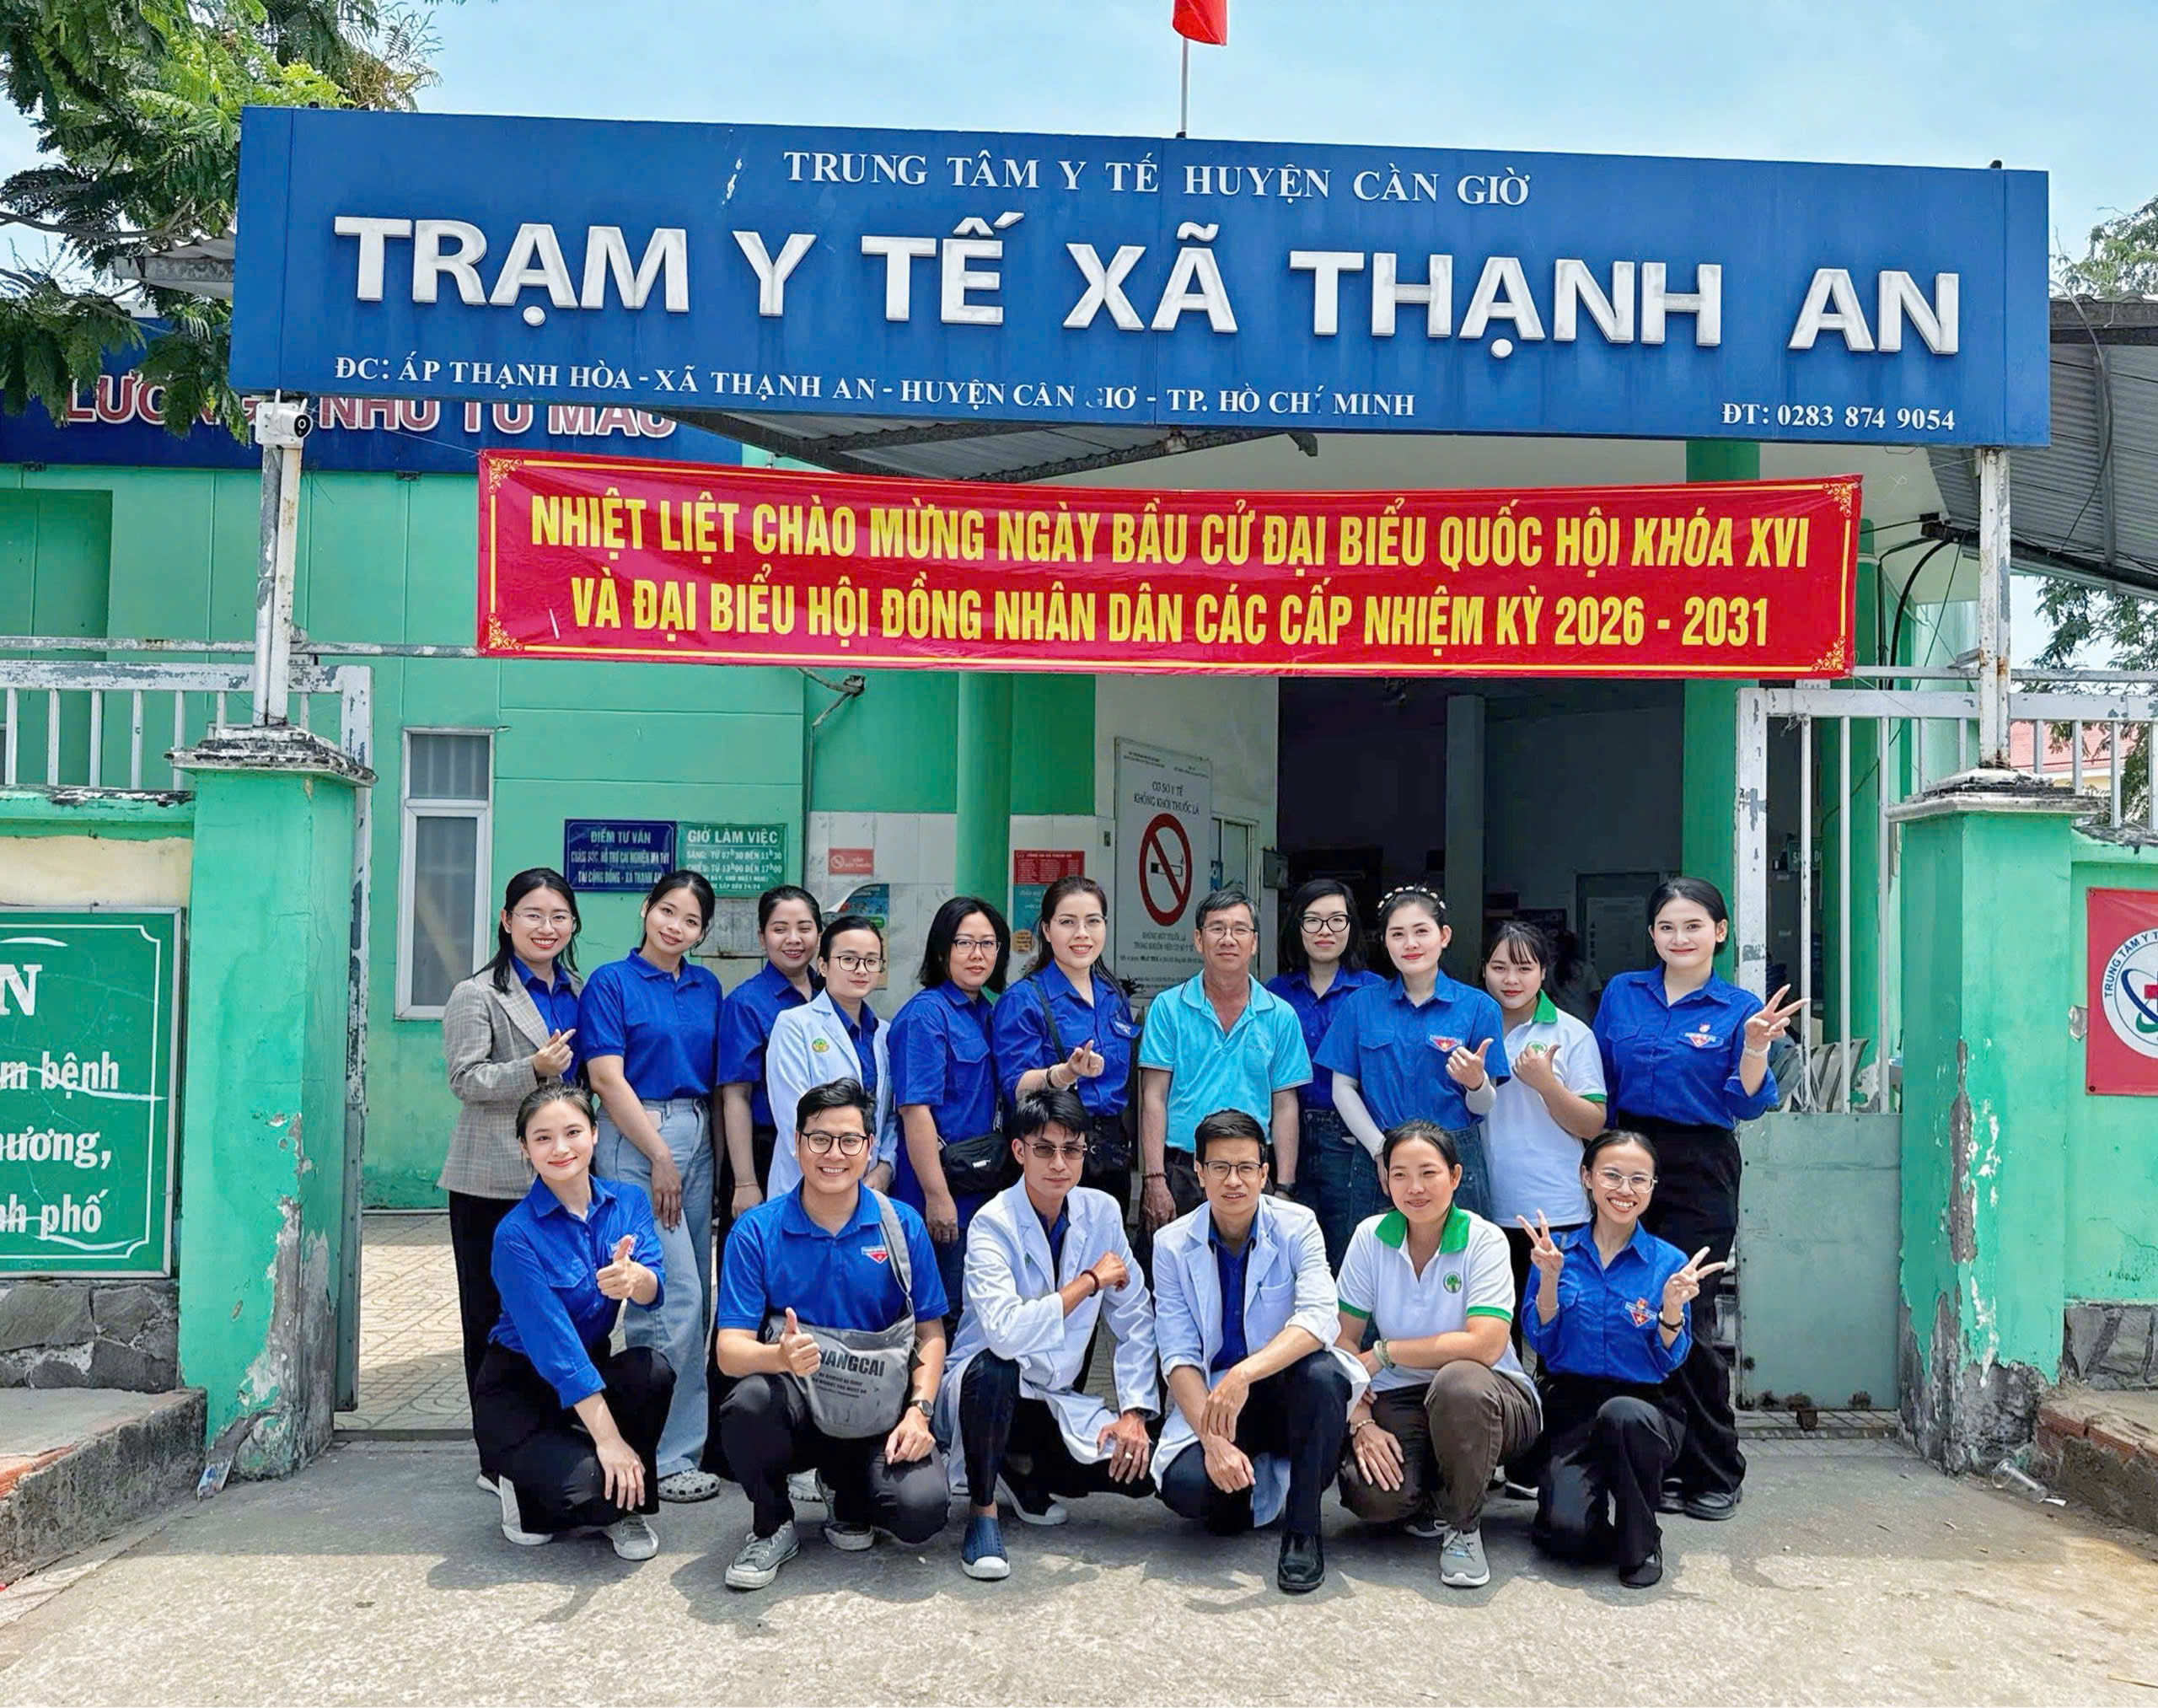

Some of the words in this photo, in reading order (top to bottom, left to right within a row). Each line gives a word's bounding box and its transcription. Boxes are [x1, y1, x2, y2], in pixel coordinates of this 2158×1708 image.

[783, 151, 928, 185] TRUNG
[946, 149, 1039, 189] TÂM
[1058, 160, 1087, 191] Y
[1105, 152, 1158, 193] TẾ
[1184, 164, 1331, 204] HUYỆN
[1353, 163, 1439, 202] CẦN
[1457, 166, 1531, 206] GIỜ
[334, 216, 690, 327] TRẠM
[733, 230, 817, 317] Y
[861, 212, 1025, 325] TẾ
[1062, 222, 1238, 335] XÃ
[1290, 250, 1722, 358] THẠNH
[1787, 268, 1960, 355] AN
[335, 356, 389, 380] ĐC:
[398, 351, 441, 382] ẤP
[450, 361, 558, 390] THẠNH
[570, 360, 632, 389] HÒA
[654, 365, 699, 393] XÃ
[711, 371, 821, 401] THẠNH
[832, 378, 877, 400] AN
[899, 379, 1006, 411] HUYỆN
[1166, 389, 1209, 411] TP.
[1218, 383, 1260, 413] HỒ
[1332, 393, 1415, 416] MINH
[1721, 403, 1769, 427] ĐT:
[1777, 405, 1833, 427] 0283
[1845, 406, 1886, 428] 874
[1897, 407, 1956, 432] 9054
[531, 487, 646, 560] NHIỆT
[660, 491, 739, 564] LIỆT
[752, 495, 856, 557] CHÀO
[869, 497, 984, 561] MỪNG
[997, 502, 1099, 563] NGÀY
[1112, 497, 1188, 565] BẦU
[1200, 499, 1256, 566] CỬ
[1263, 514, 1326, 577] ĐẠI
[1339, 497, 1426, 567] BIỂU
[1439, 499, 1543, 572] QUỐC
[1556, 508, 1619, 578] HỘI
[1631, 507, 1734, 567] KHÓA
[1745, 518, 1810, 568] XVI
[571, 567, 621, 630] VÀ
[632, 579, 697, 642] ĐẠI
[710, 564, 795, 634] BIỂU
[808, 575, 869, 647] HỘI
[881, 571, 982, 642] ĐỒNG
[995, 581, 1096, 642] NHÂN
[1109, 583, 1183, 642] DÂN
[1195, 583, 1268, 644] CÁC
[1280, 577, 1351, 645] CẤP
[1364, 585, 1484, 656] NHIỆM
[1496, 585, 1544, 646] KỲ
[1555, 595, 1645, 647] 2026
[1657, 619, 1671, 630] -
[1681, 597, 1768, 647] 2031
[747, 828, 778, 846] VIỆC
[2104, 959, 2121, 998] TRUNG
[40, 1050, 119, 1099] bệnh
[40, 1189, 110, 1241] phố
